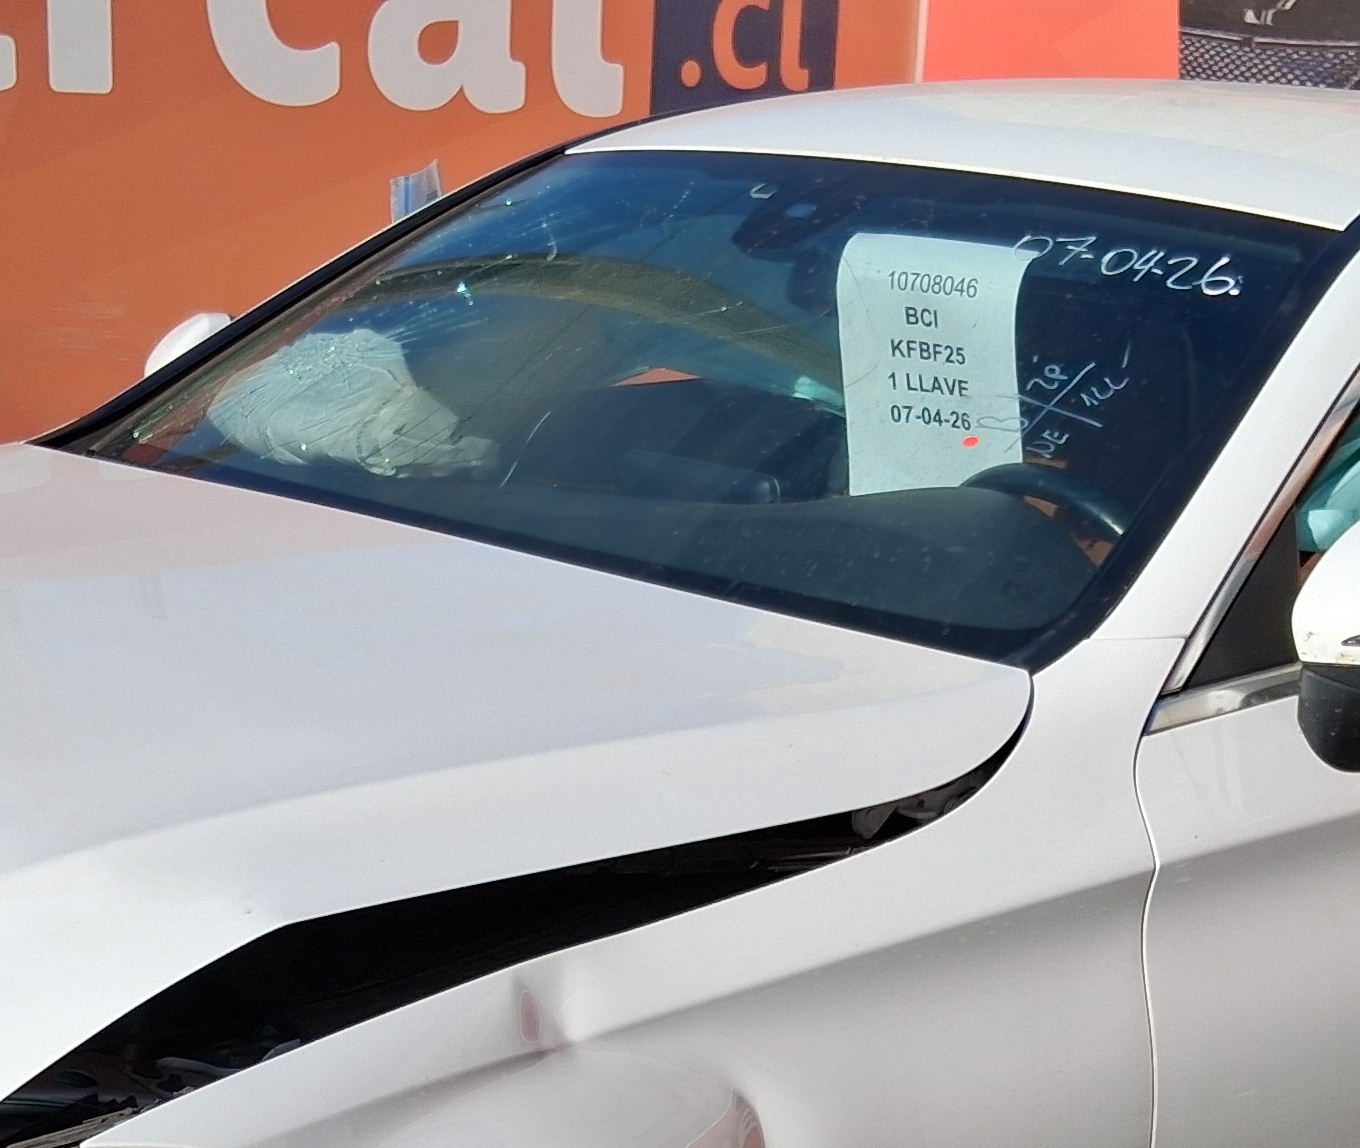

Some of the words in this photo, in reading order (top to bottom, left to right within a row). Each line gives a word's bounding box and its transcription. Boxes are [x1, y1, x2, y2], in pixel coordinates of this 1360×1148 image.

[888, 270, 979, 299] 10708046
[904, 305, 939, 329] BCI
[890, 338, 967, 366] KFBF25
[888, 371, 898, 391] 1
[905, 372, 970, 398] LLAVE
[890, 404, 972, 432] 07-04-26
